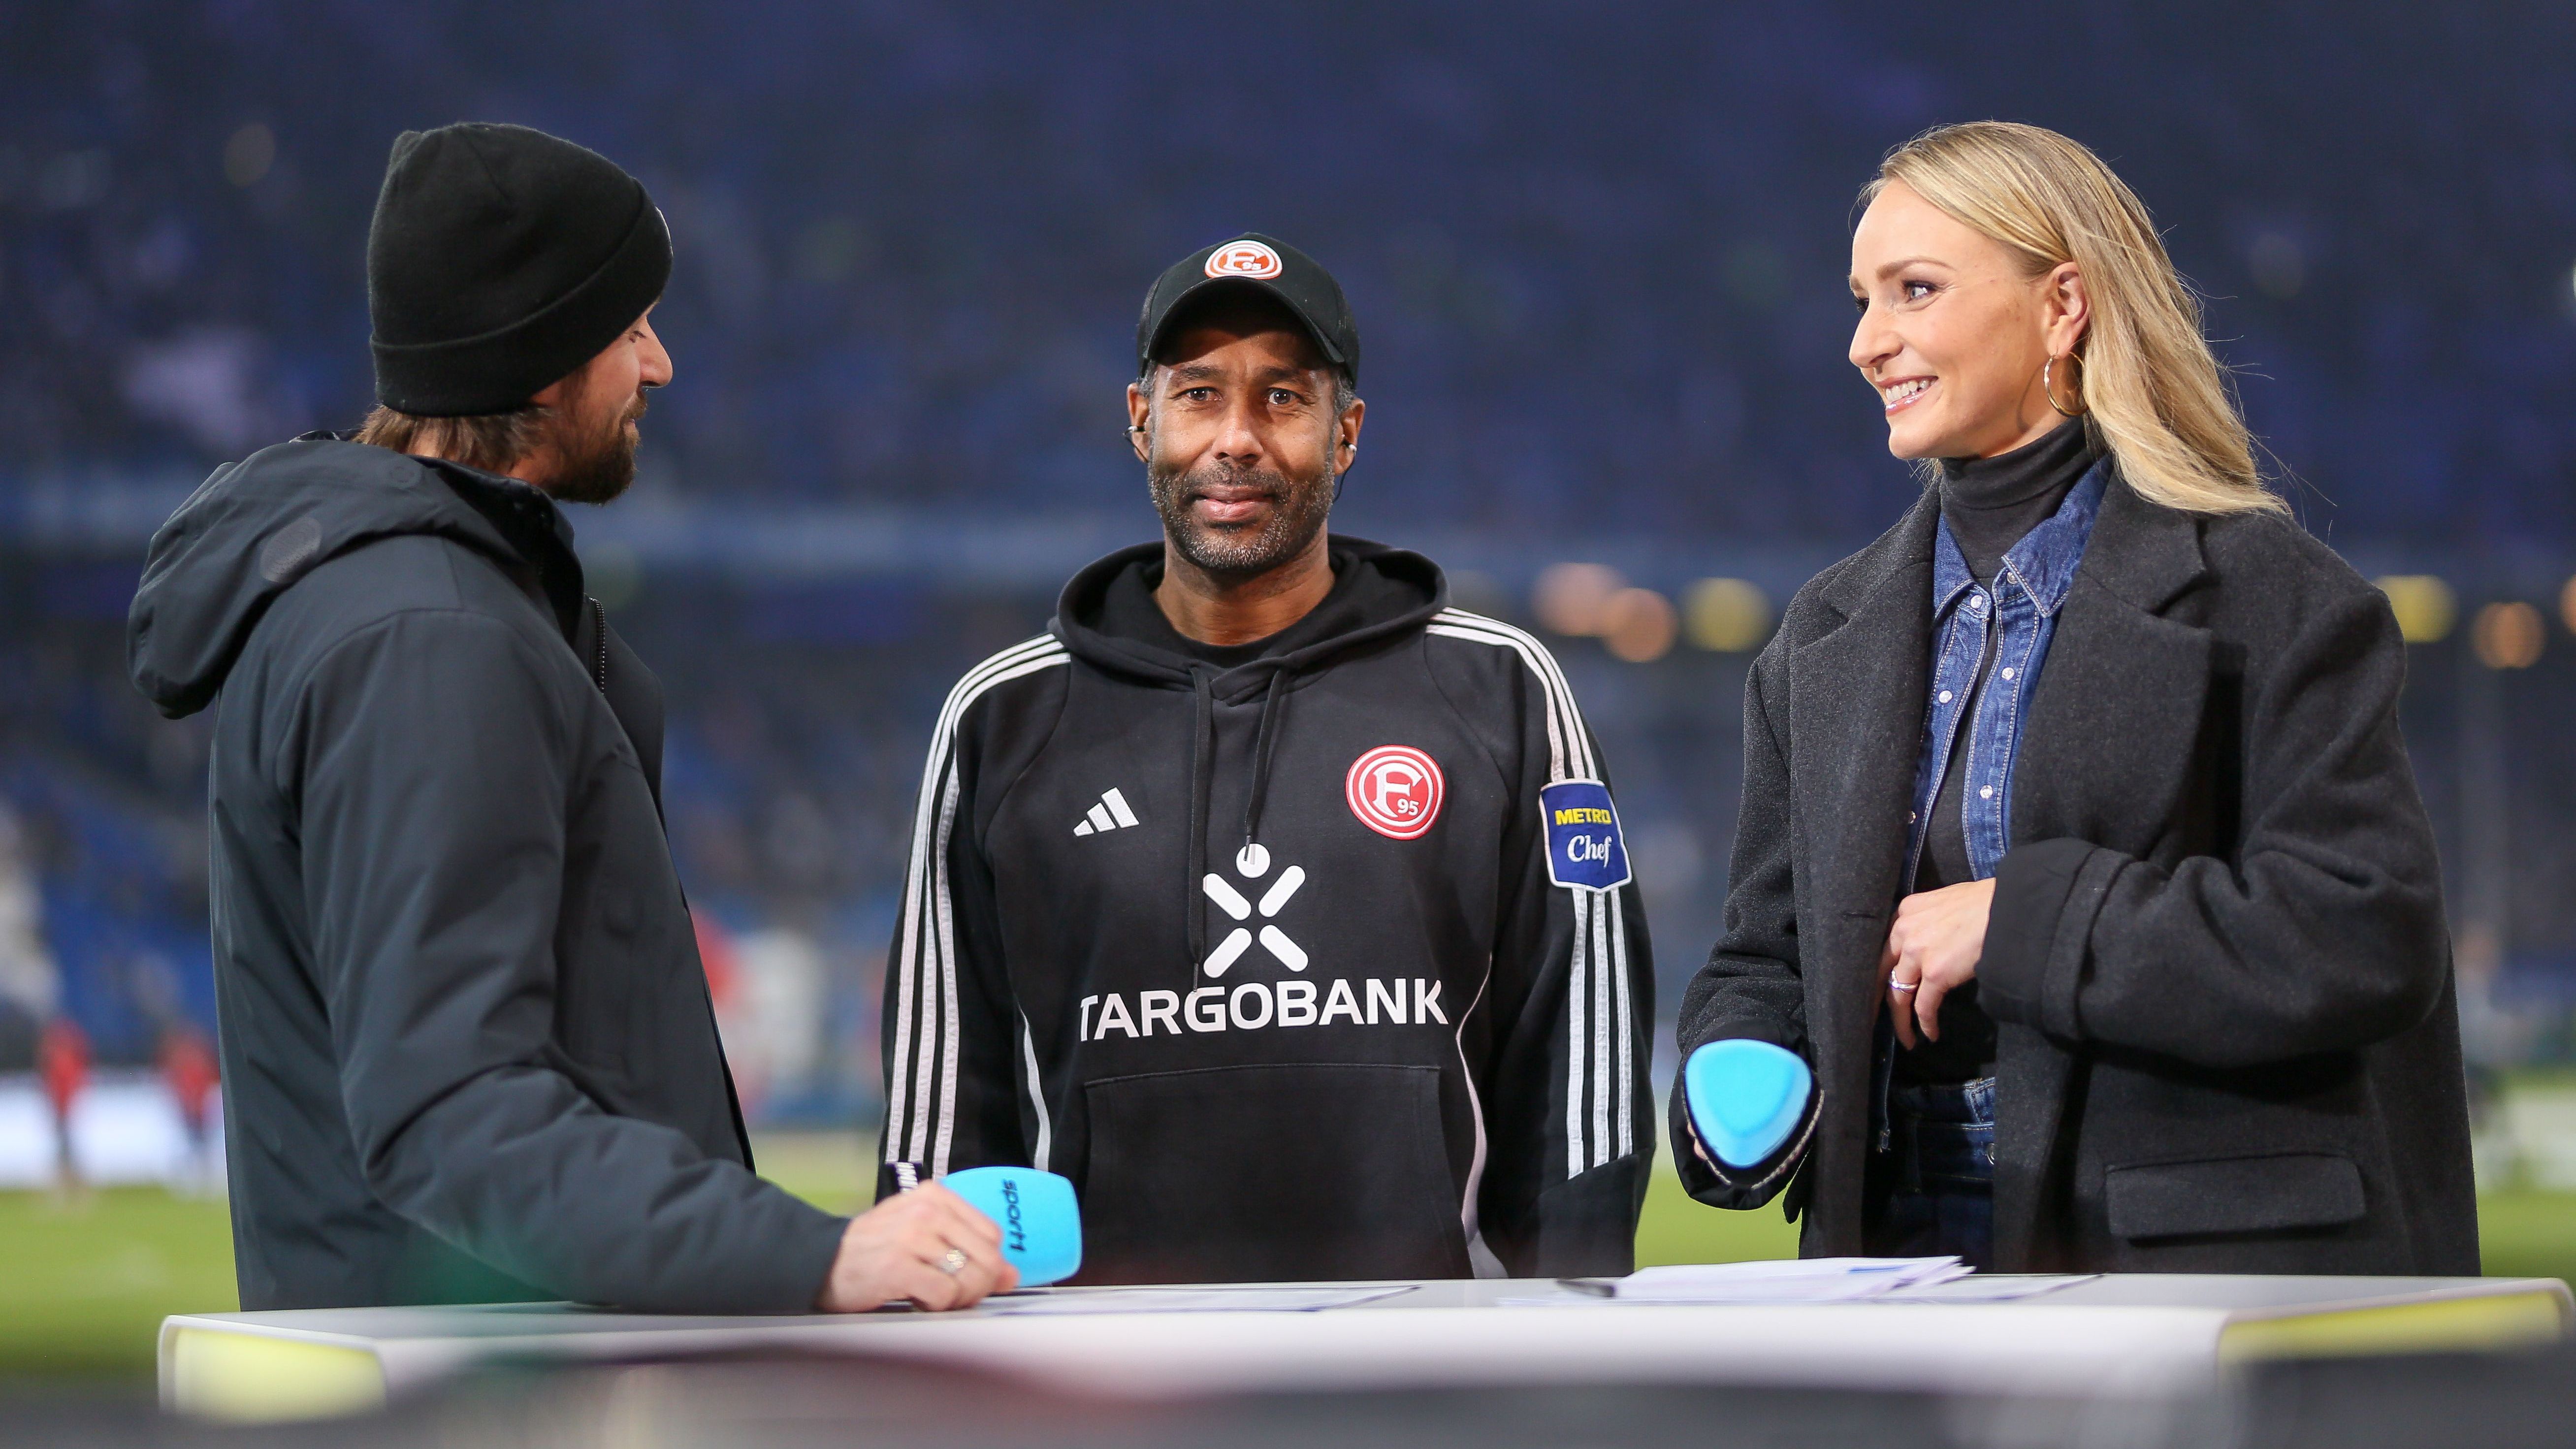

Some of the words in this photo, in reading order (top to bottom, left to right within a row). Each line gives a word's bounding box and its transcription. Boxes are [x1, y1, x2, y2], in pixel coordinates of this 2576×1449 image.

[1372, 763, 1423, 818] F
[1397, 798, 1420, 816] 95
[1554, 807, 1612, 826] METRO
[1567, 835, 1612, 869] Chef
[1080, 978, 1449, 1042] TARGOBANK
